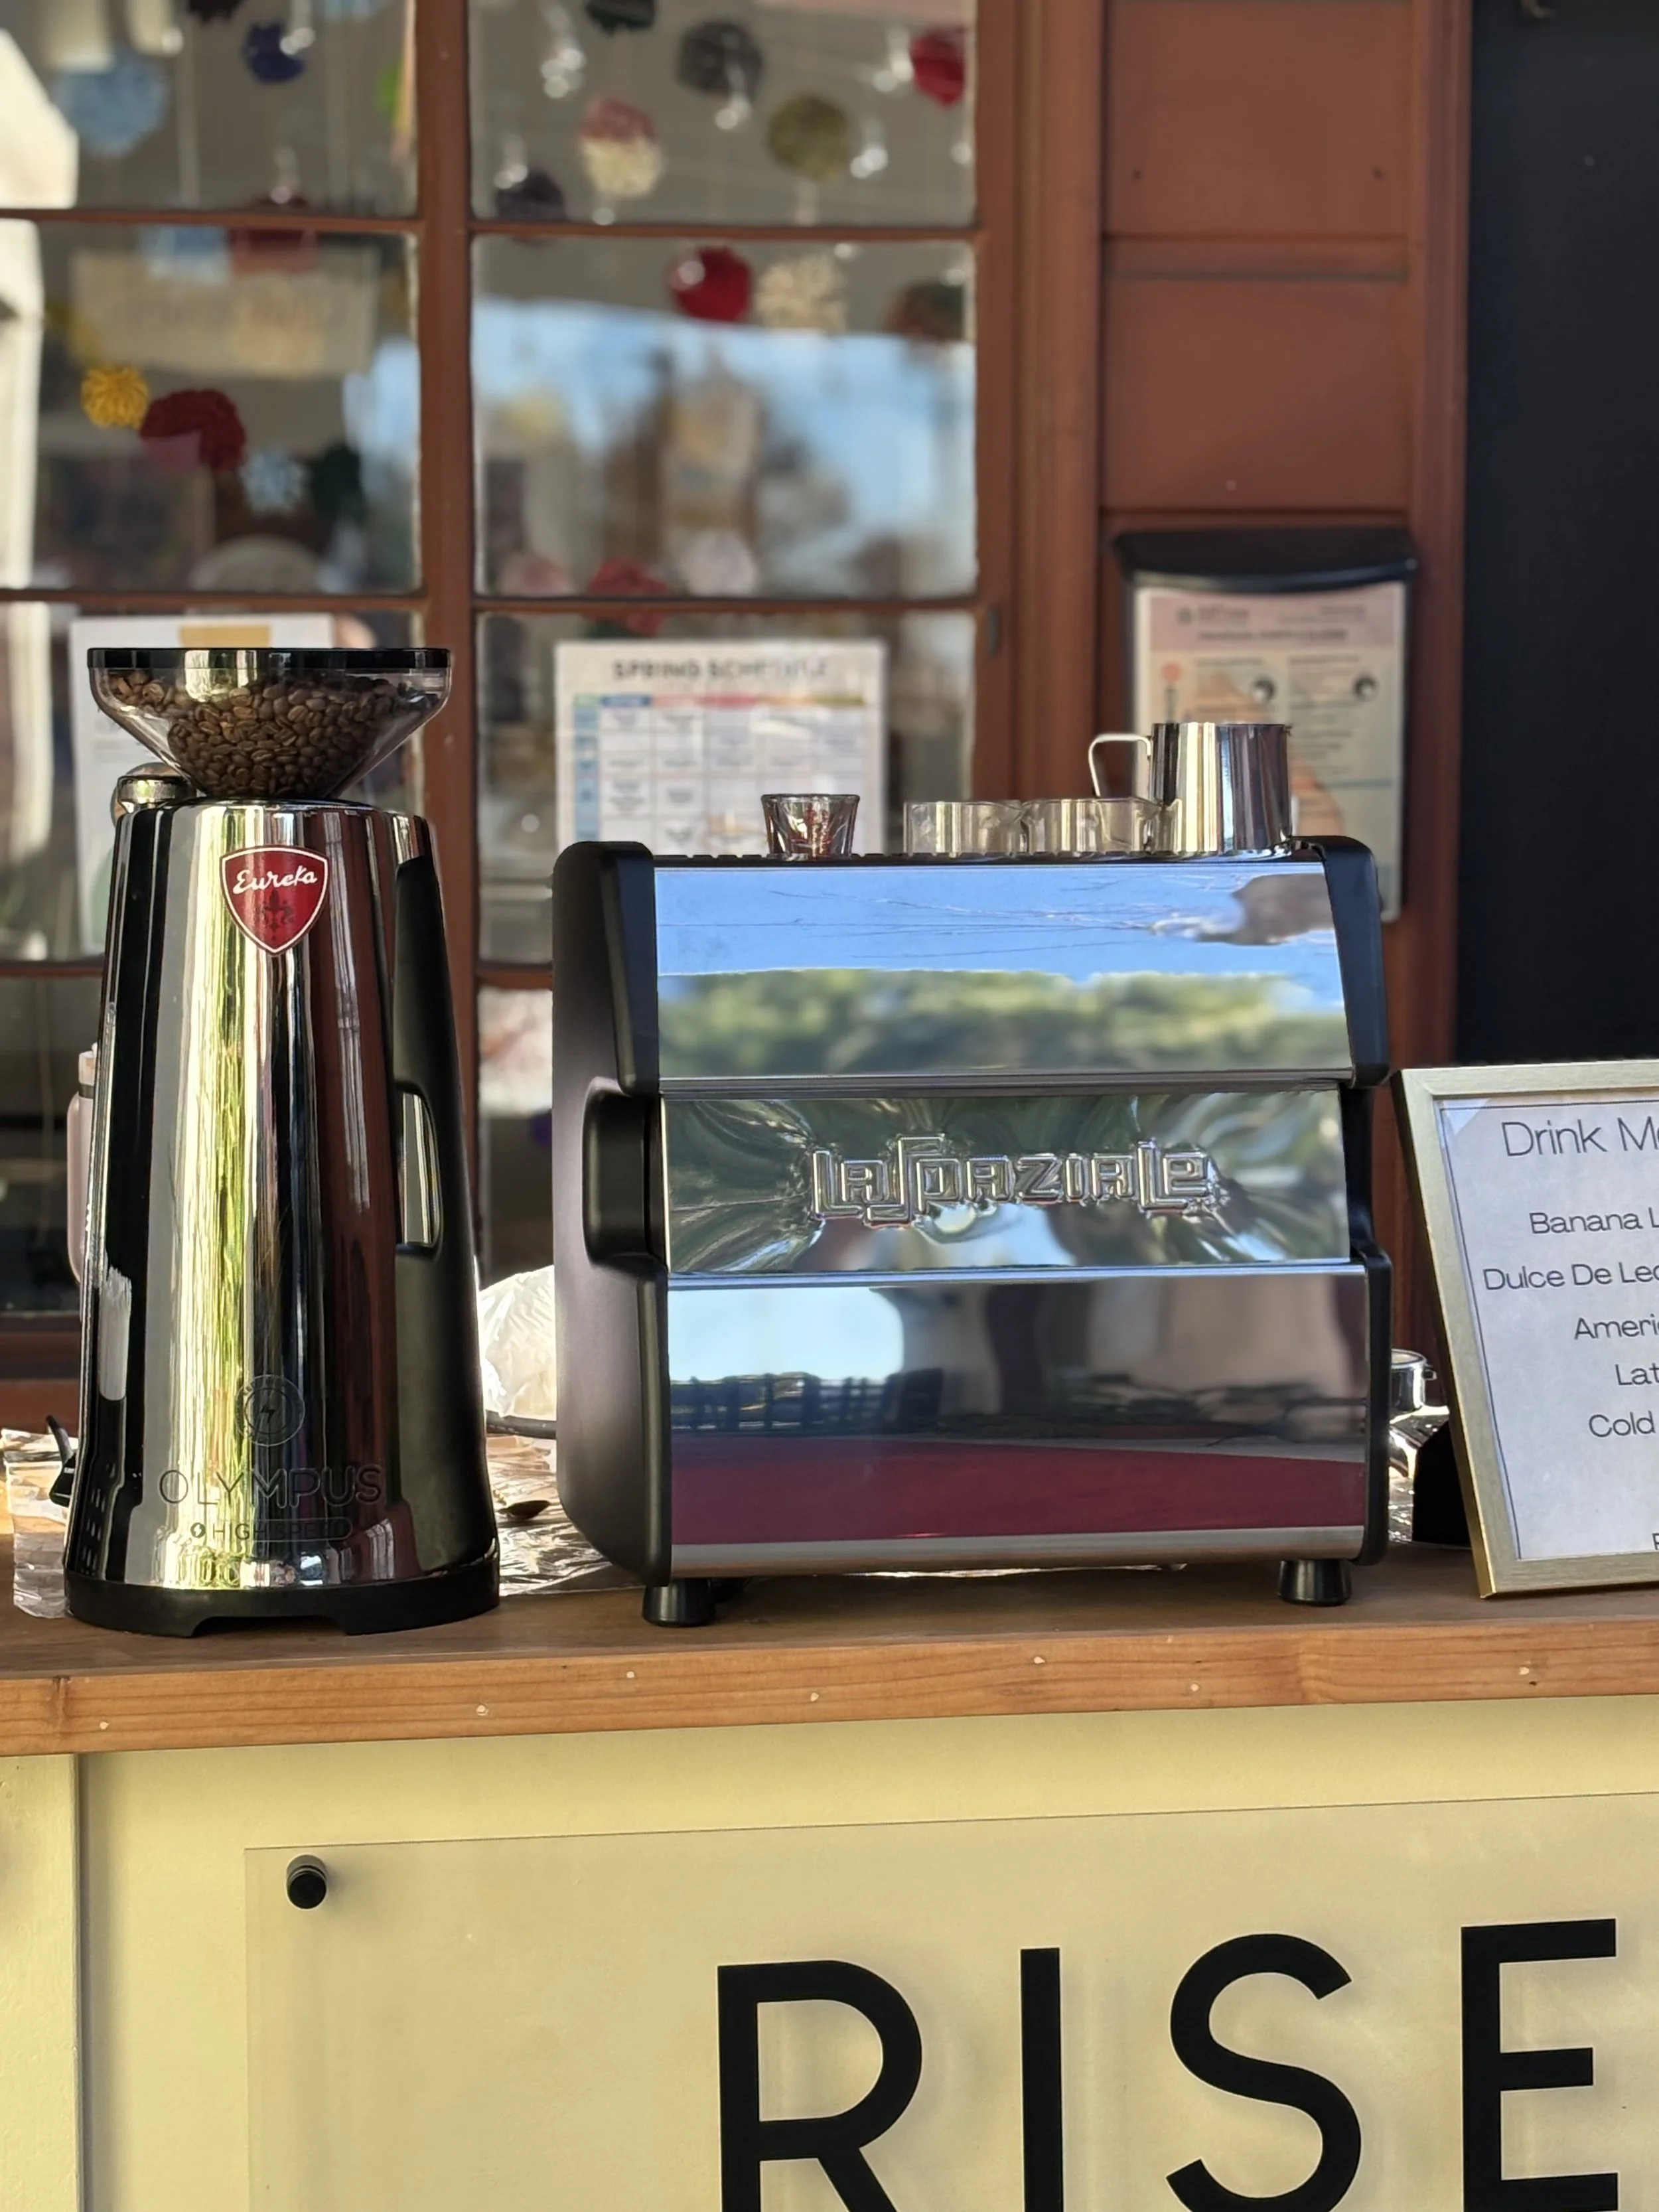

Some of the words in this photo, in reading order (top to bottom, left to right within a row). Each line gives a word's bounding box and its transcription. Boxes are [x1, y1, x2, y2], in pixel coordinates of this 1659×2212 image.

[233, 865, 318, 894] Eureka
[1501, 1119, 1608, 1157] Drink
[1617, 1116, 1659, 1151] M
[1529, 1212, 1644, 1234] Banana
[1483, 1265, 1565, 1290] Dulce
[1571, 1264, 1613, 1286] De
[1574, 1313, 1659, 1340] Ameri
[1589, 1410, 1656, 1438] Cold
[159, 1465, 382, 1509] OLYMPUS
[212, 1522, 266, 1541] HIGH
[717, 1918, 1619, 2212] RISE
